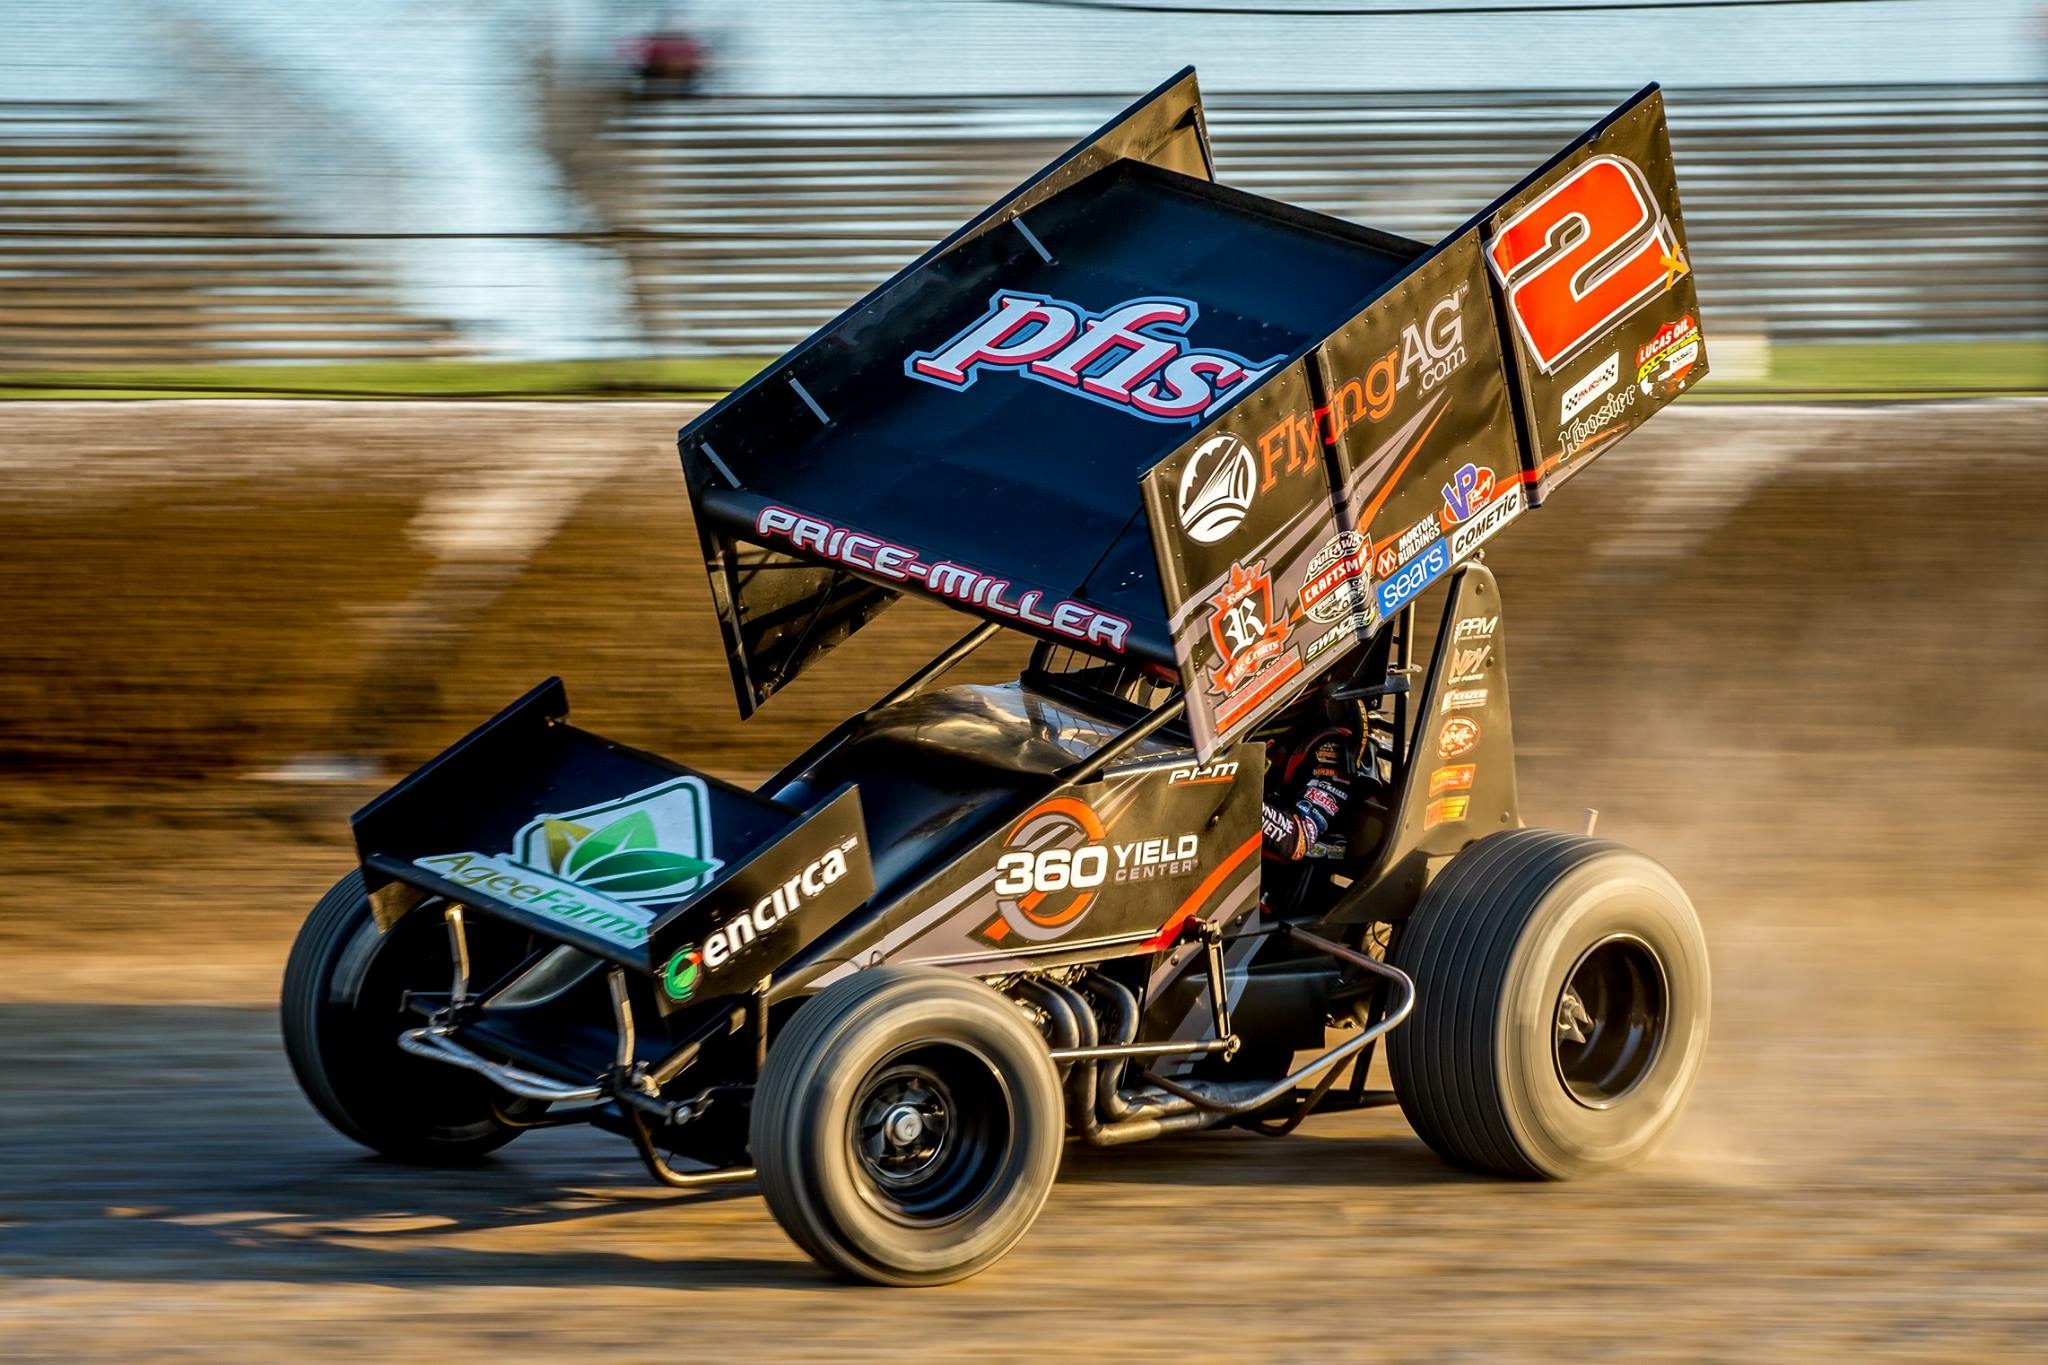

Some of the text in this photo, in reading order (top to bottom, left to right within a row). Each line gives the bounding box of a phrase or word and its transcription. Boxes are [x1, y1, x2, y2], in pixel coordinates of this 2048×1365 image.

[1485, 155, 1687, 374] 2
[1640, 330, 1672, 363] LUCAS
[1673, 319, 1689, 339] OIL
[1558, 385, 1636, 463] Hoosier
[1441, 463, 1478, 522] VP
[1398, 513, 1435, 551] MORTON
[1398, 521, 1440, 564] BUILDINGS
[756, 506, 1131, 652] PRICE-MILLER
[1383, 548, 1444, 608] sears
[994, 834, 1198, 895] 360 YIELD
[1114, 861, 1193, 882] CENTER
[425, 853, 650, 943] AgeeFarms
[703, 846, 848, 968] encirca
